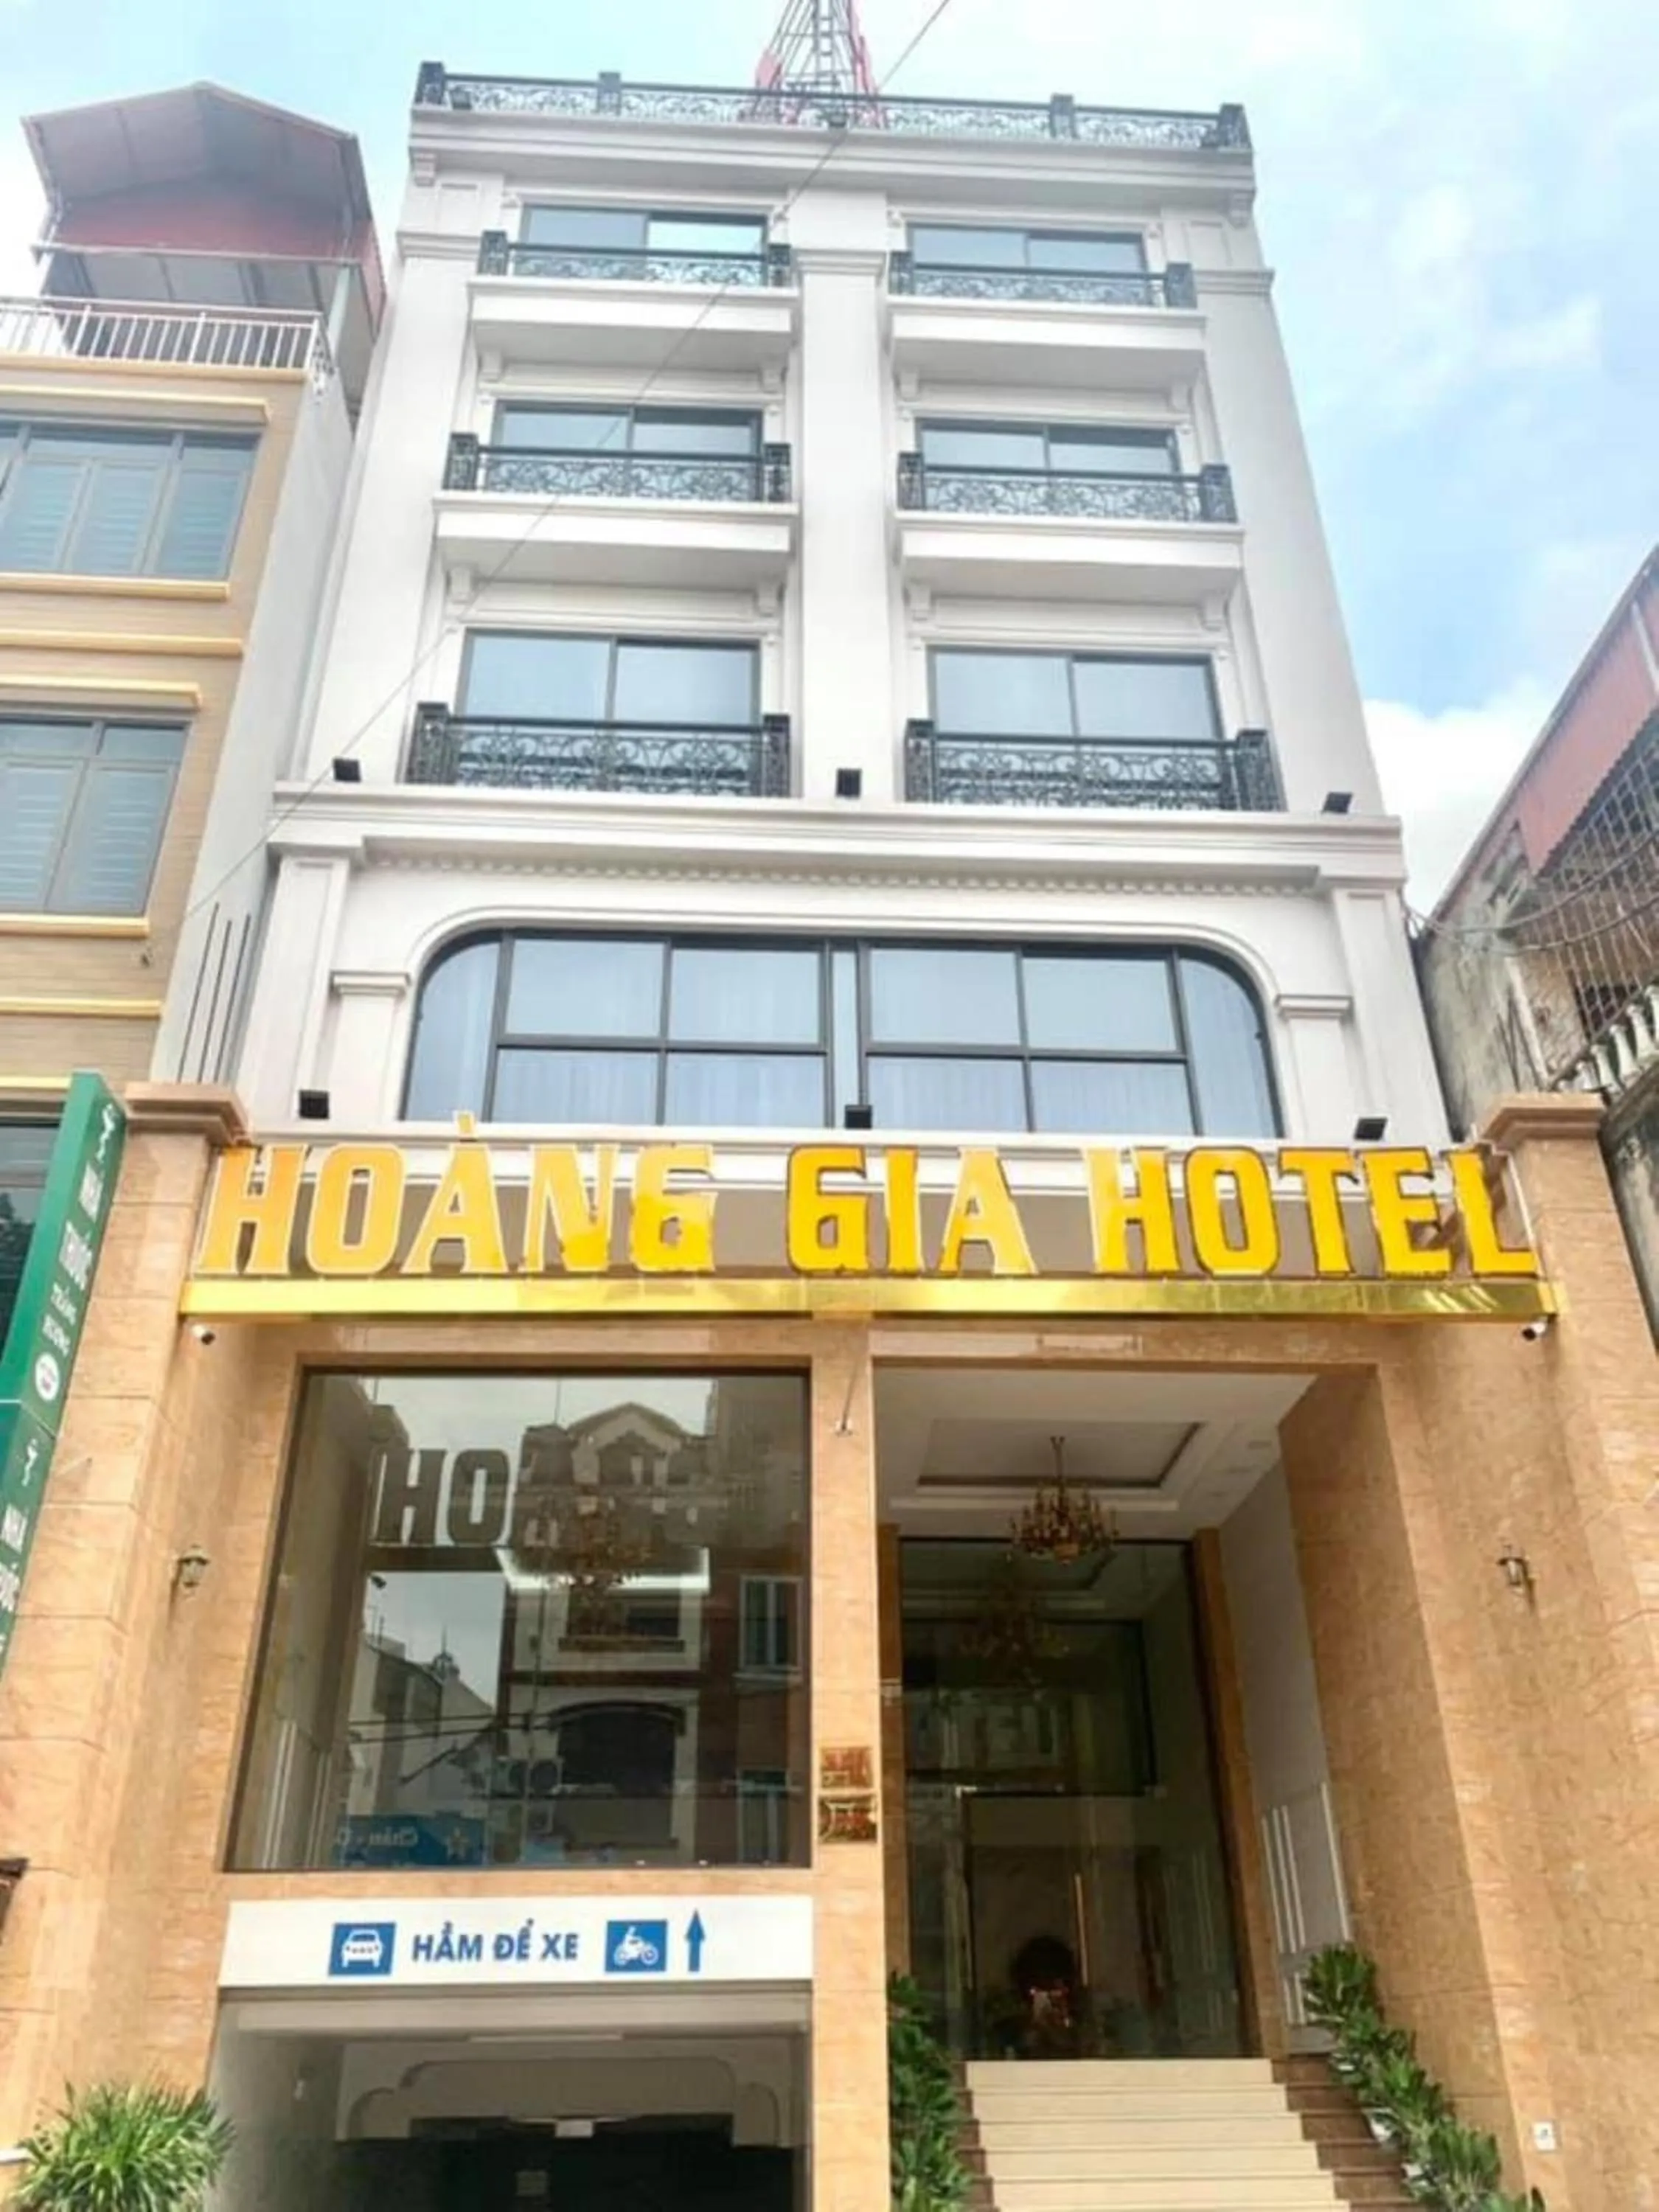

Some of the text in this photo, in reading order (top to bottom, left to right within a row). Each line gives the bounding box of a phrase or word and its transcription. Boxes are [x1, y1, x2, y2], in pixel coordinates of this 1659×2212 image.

[194, 1112, 716, 1276] HOÀNG
[786, 1145, 1038, 1276] GIA
[1082, 1145, 1538, 1279] HOTEL
[493, 1917, 534, 1961] ĐỂ
[540, 1932, 579, 1961] XE
